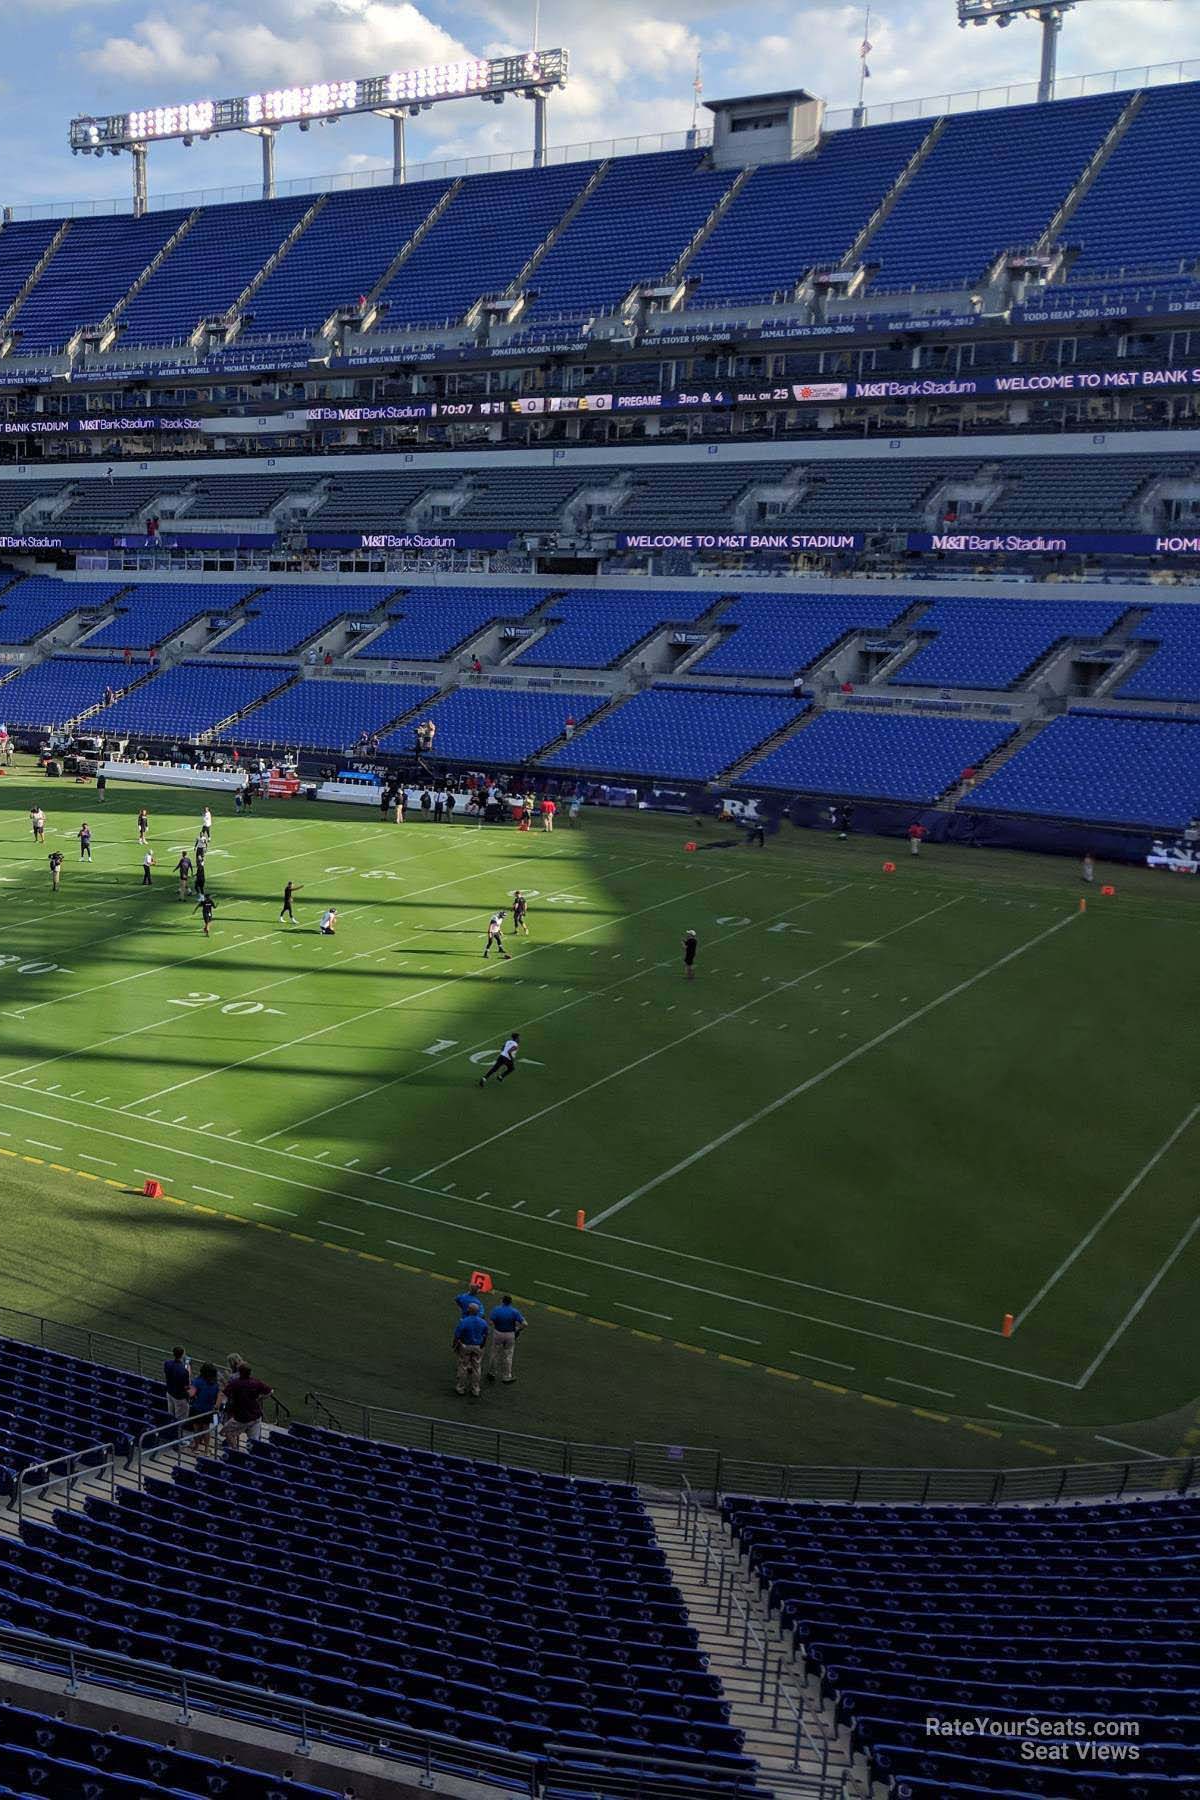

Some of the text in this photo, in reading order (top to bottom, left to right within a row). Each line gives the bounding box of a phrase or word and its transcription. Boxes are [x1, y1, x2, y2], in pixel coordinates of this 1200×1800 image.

[1023, 306, 1127, 322] TODD HEAP 2001-2010
[760, 325, 855, 339] JAMAL LEWIS 2000-2006
[641, 333, 730, 346] MATT STOVER 1996-2008
[491, 343, 588, 357] JONATHAN OGDEN 1996-2007
[349, 353, 436, 366] PETER BOULWARE 1997-2005
[188, 367, 210, 375] MODELL
[224, 365, 249, 373] MICHAEL
[996, 377, 1073, 392] WELCOME
[1078, 375, 1100, 387] TO
[1103, 372, 1139, 386] M&T
[1142, 370, 1188, 384] BANK
[738, 388, 789, 402] BALL ON 25
[855, 383, 889, 397] M&T
[889, 382, 921, 396] Bank
[921, 380, 977, 395] Stadium
[618, 395, 662, 407] PREGAME
[678, 392, 723, 404] 3RD & 4
[441, 404, 473, 415] 70:07
[527, 400, 536, 412] 0
[338, 406, 426, 420] M&T Bank Stadium
[5, 423, 30, 432] BANK
[31, 421, 69, 432] STADIUM
[79, 418, 154, 430] M&T Bank Stadium
[7, 537, 28, 547] Bank
[28, 536, 61, 547] Stadium
[362, 534, 456, 548] M&T Bank Stadium
[627, 535, 854, 548] WELCOME TO M&T BANK STADIUM
[931, 535, 1067, 551] M&T Bank Stadium
[166, 992, 266, 1016] 20
[474, 1274, 485, 1290] G
